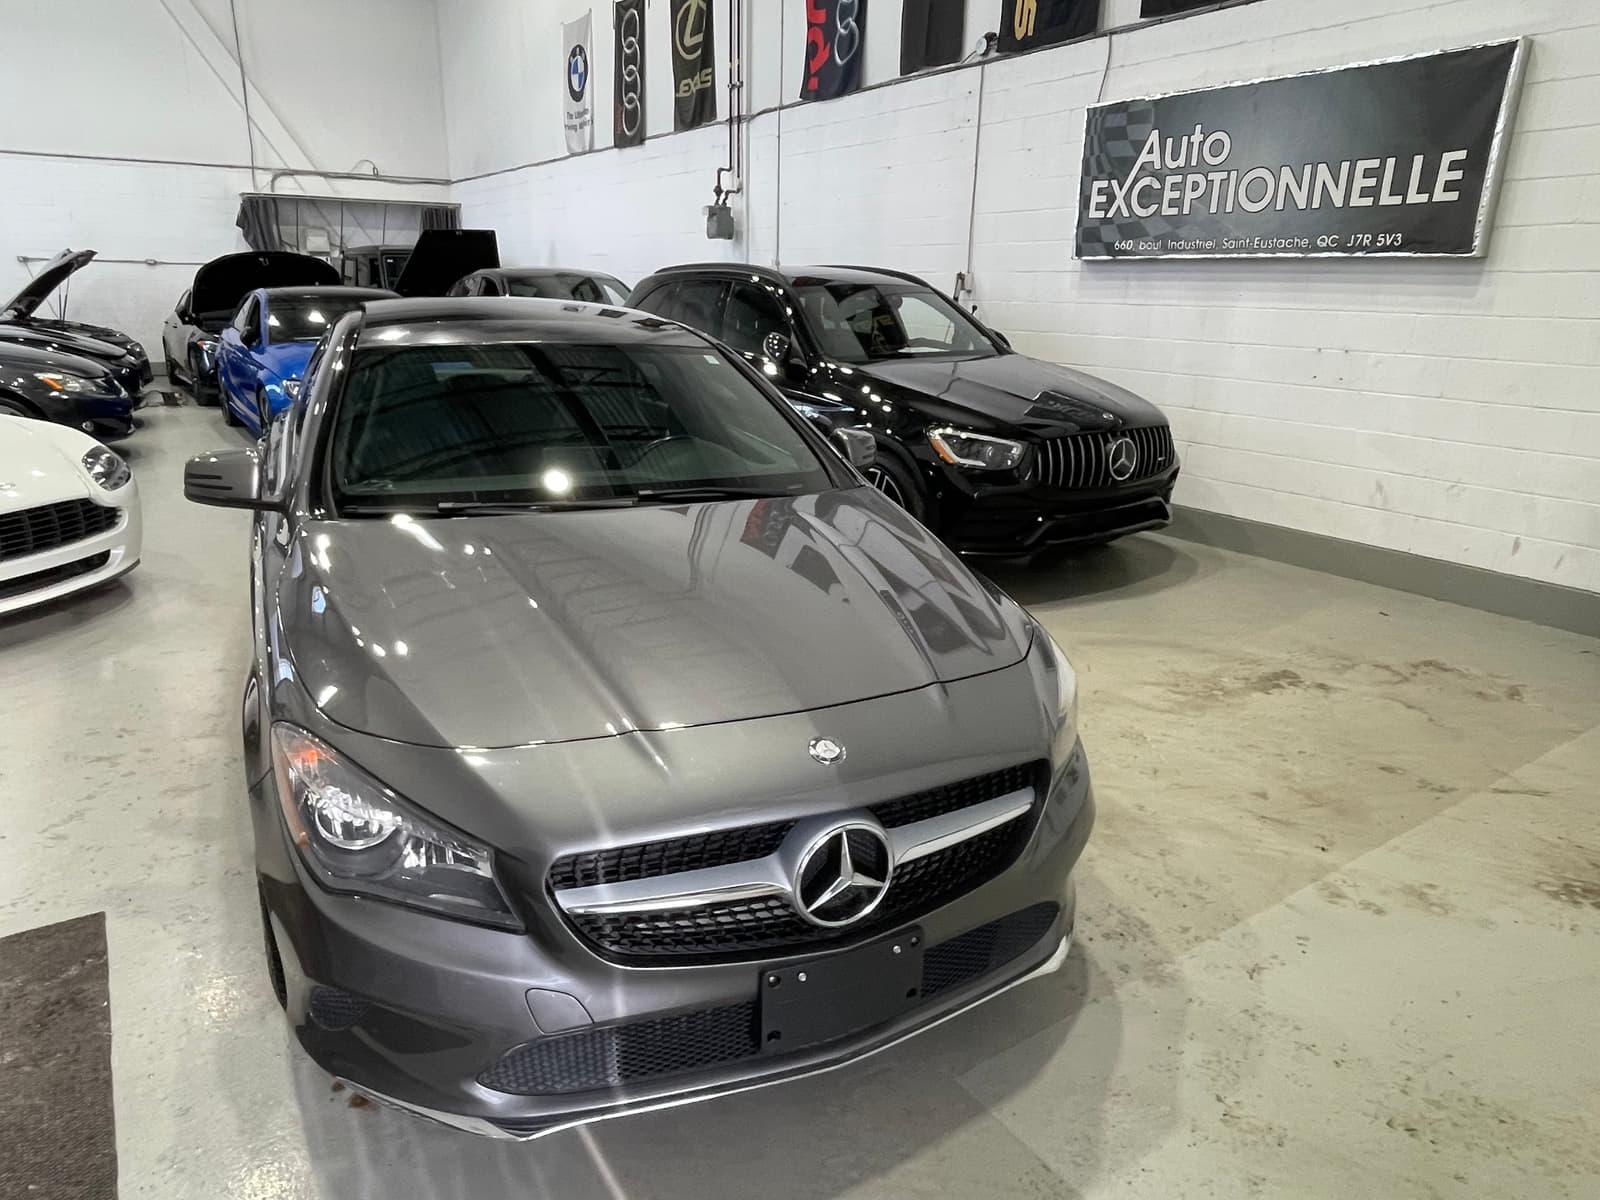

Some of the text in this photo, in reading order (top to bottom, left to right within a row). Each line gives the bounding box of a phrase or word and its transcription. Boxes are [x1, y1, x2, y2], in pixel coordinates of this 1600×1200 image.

[1138, 124, 1231, 169] Auto
[1088, 149, 1468, 218] EXCEPTIONNELLE
[1222, 237, 1312, 249] Saint-Eustache,
[1316, 235, 1339, 248] QC
[1346, 234, 1372, 247] J7R
[1376, 233, 1402, 246] 5V3
